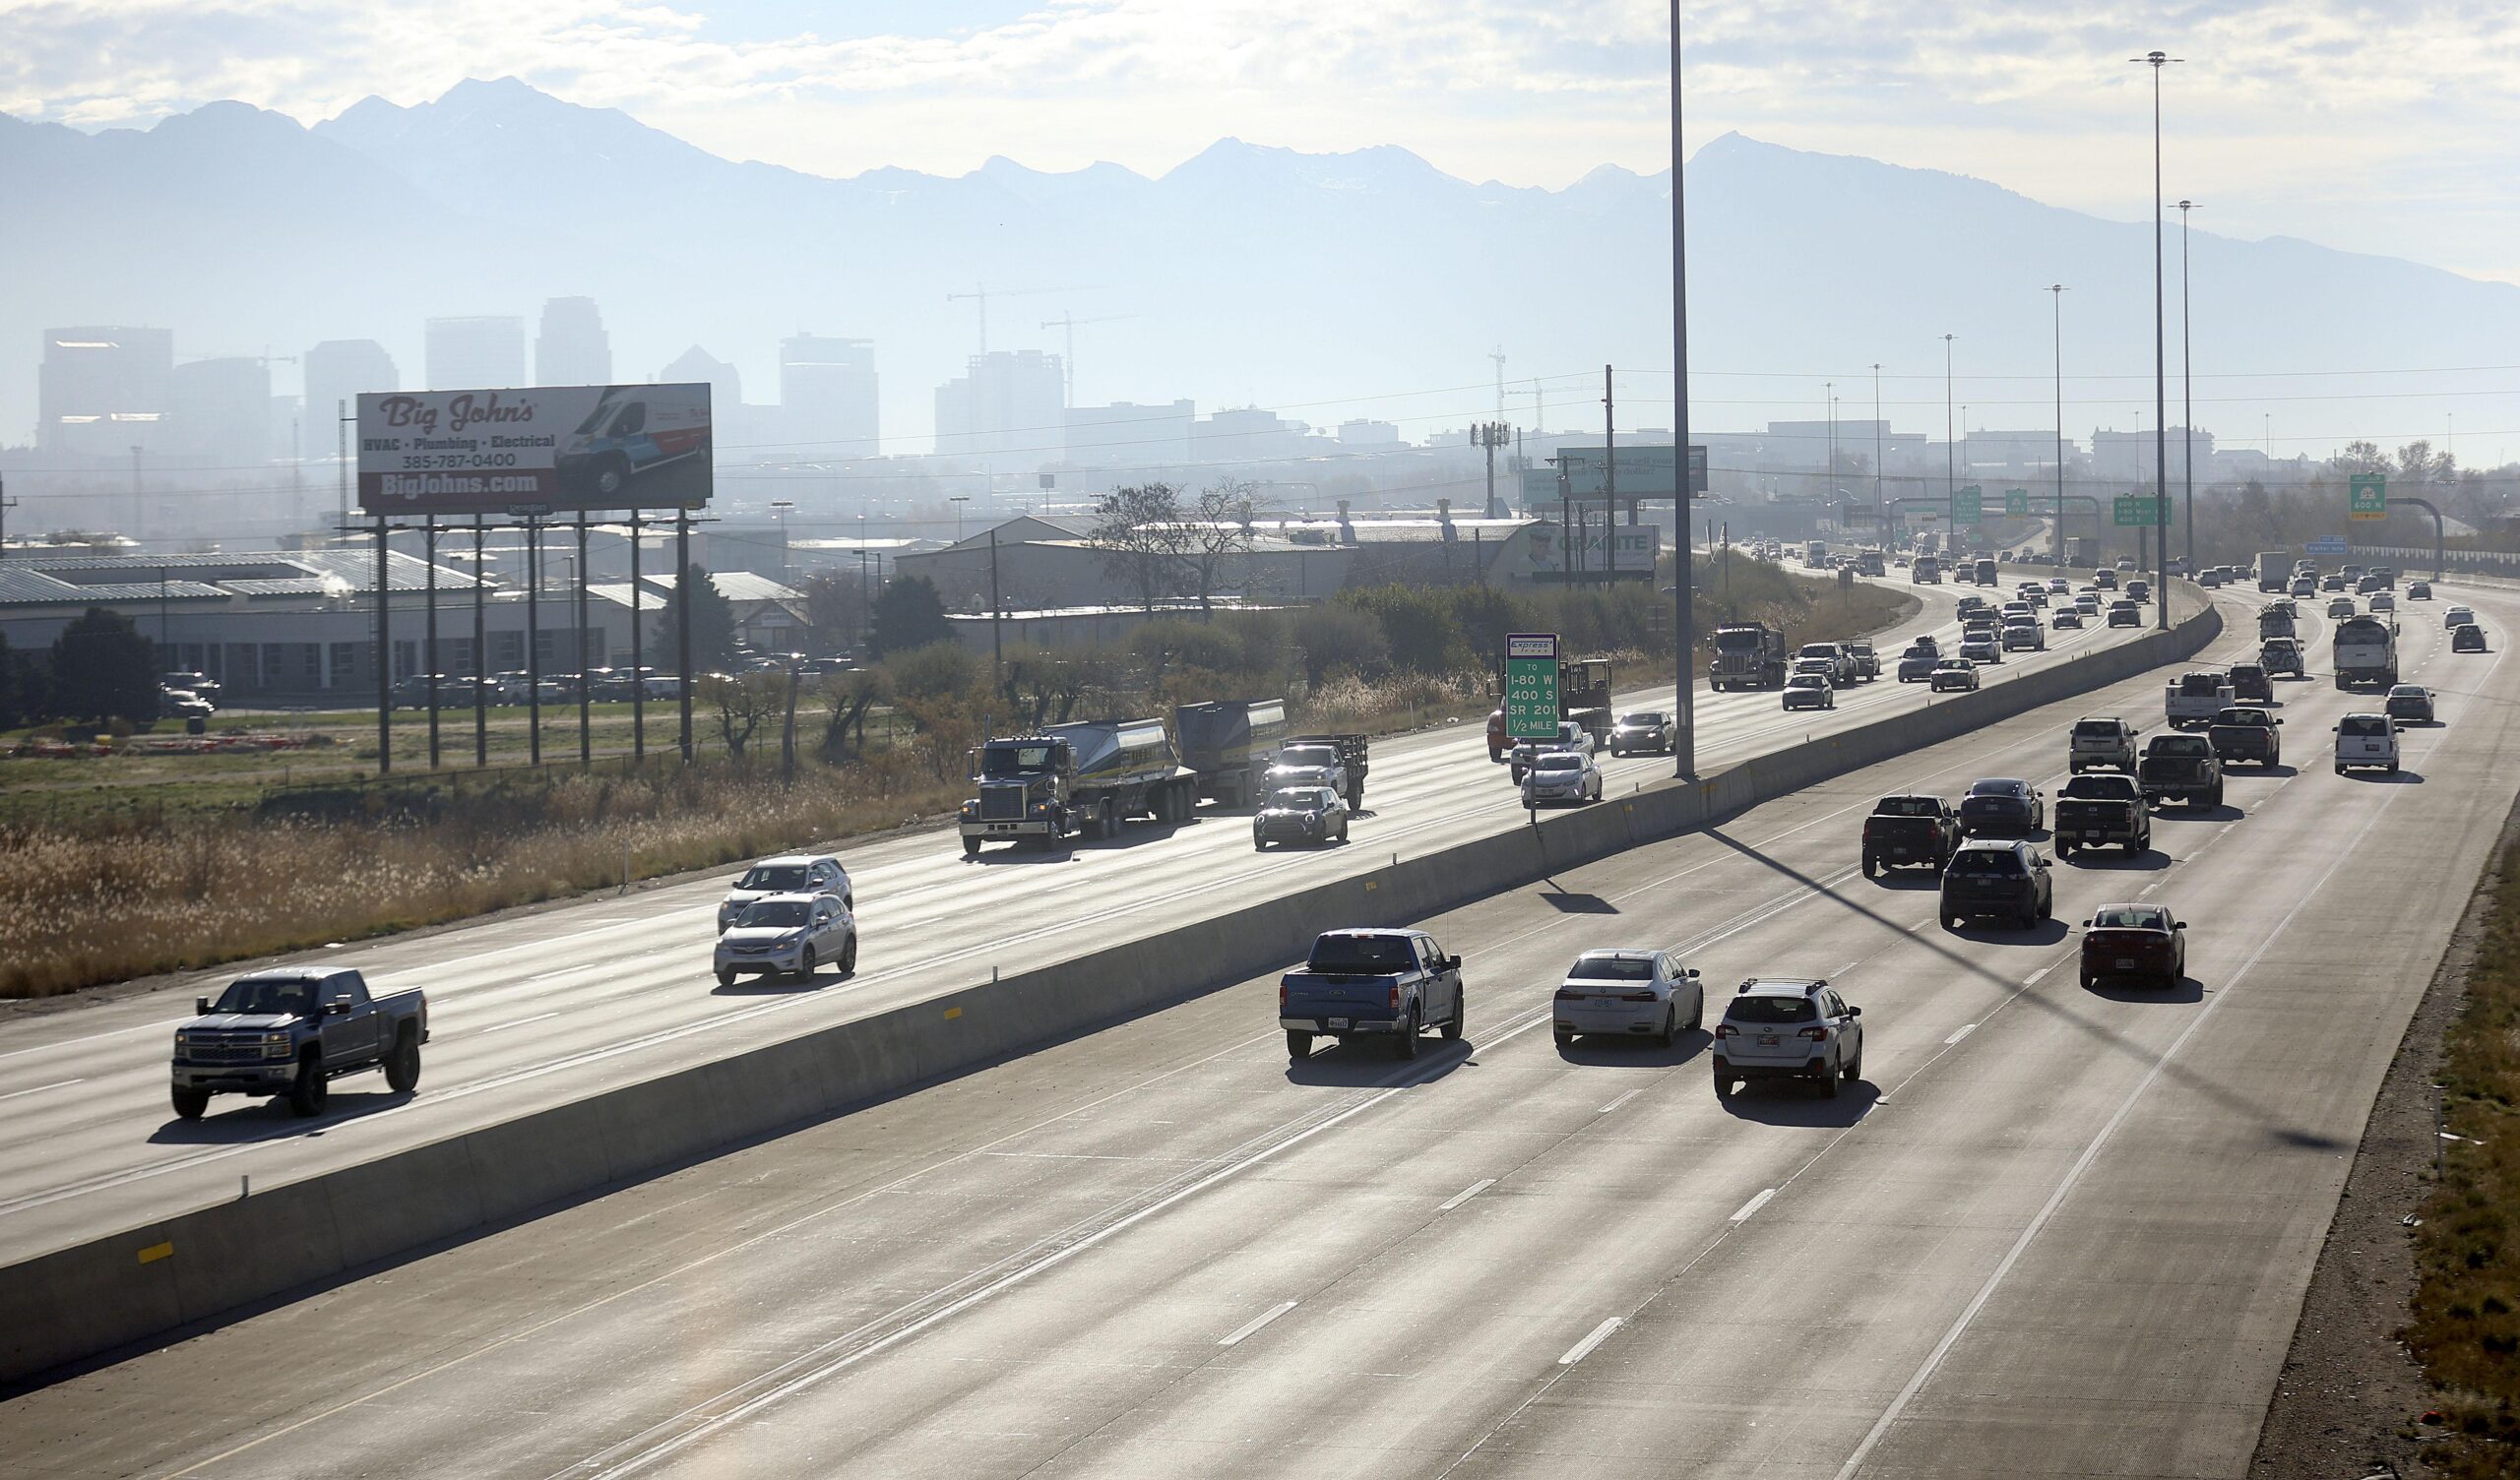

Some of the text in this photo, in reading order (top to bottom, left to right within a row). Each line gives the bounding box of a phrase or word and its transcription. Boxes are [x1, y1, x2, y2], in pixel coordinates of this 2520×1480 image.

[379, 394, 534, 435] Big John's
[363, 434, 555, 452] HVAC Plumbing Electrical
[403, 453, 516, 468] 385-787-0400
[381, 473, 538, 500] BigJohns.com
[2355, 501, 2371, 510] 600
[1511, 675, 1553, 685] I-80 W
[1512, 691, 1553, 701] 400 S
[1510, 706, 1555, 715] SR 201
[1530, 721, 1552, 730] MILE
